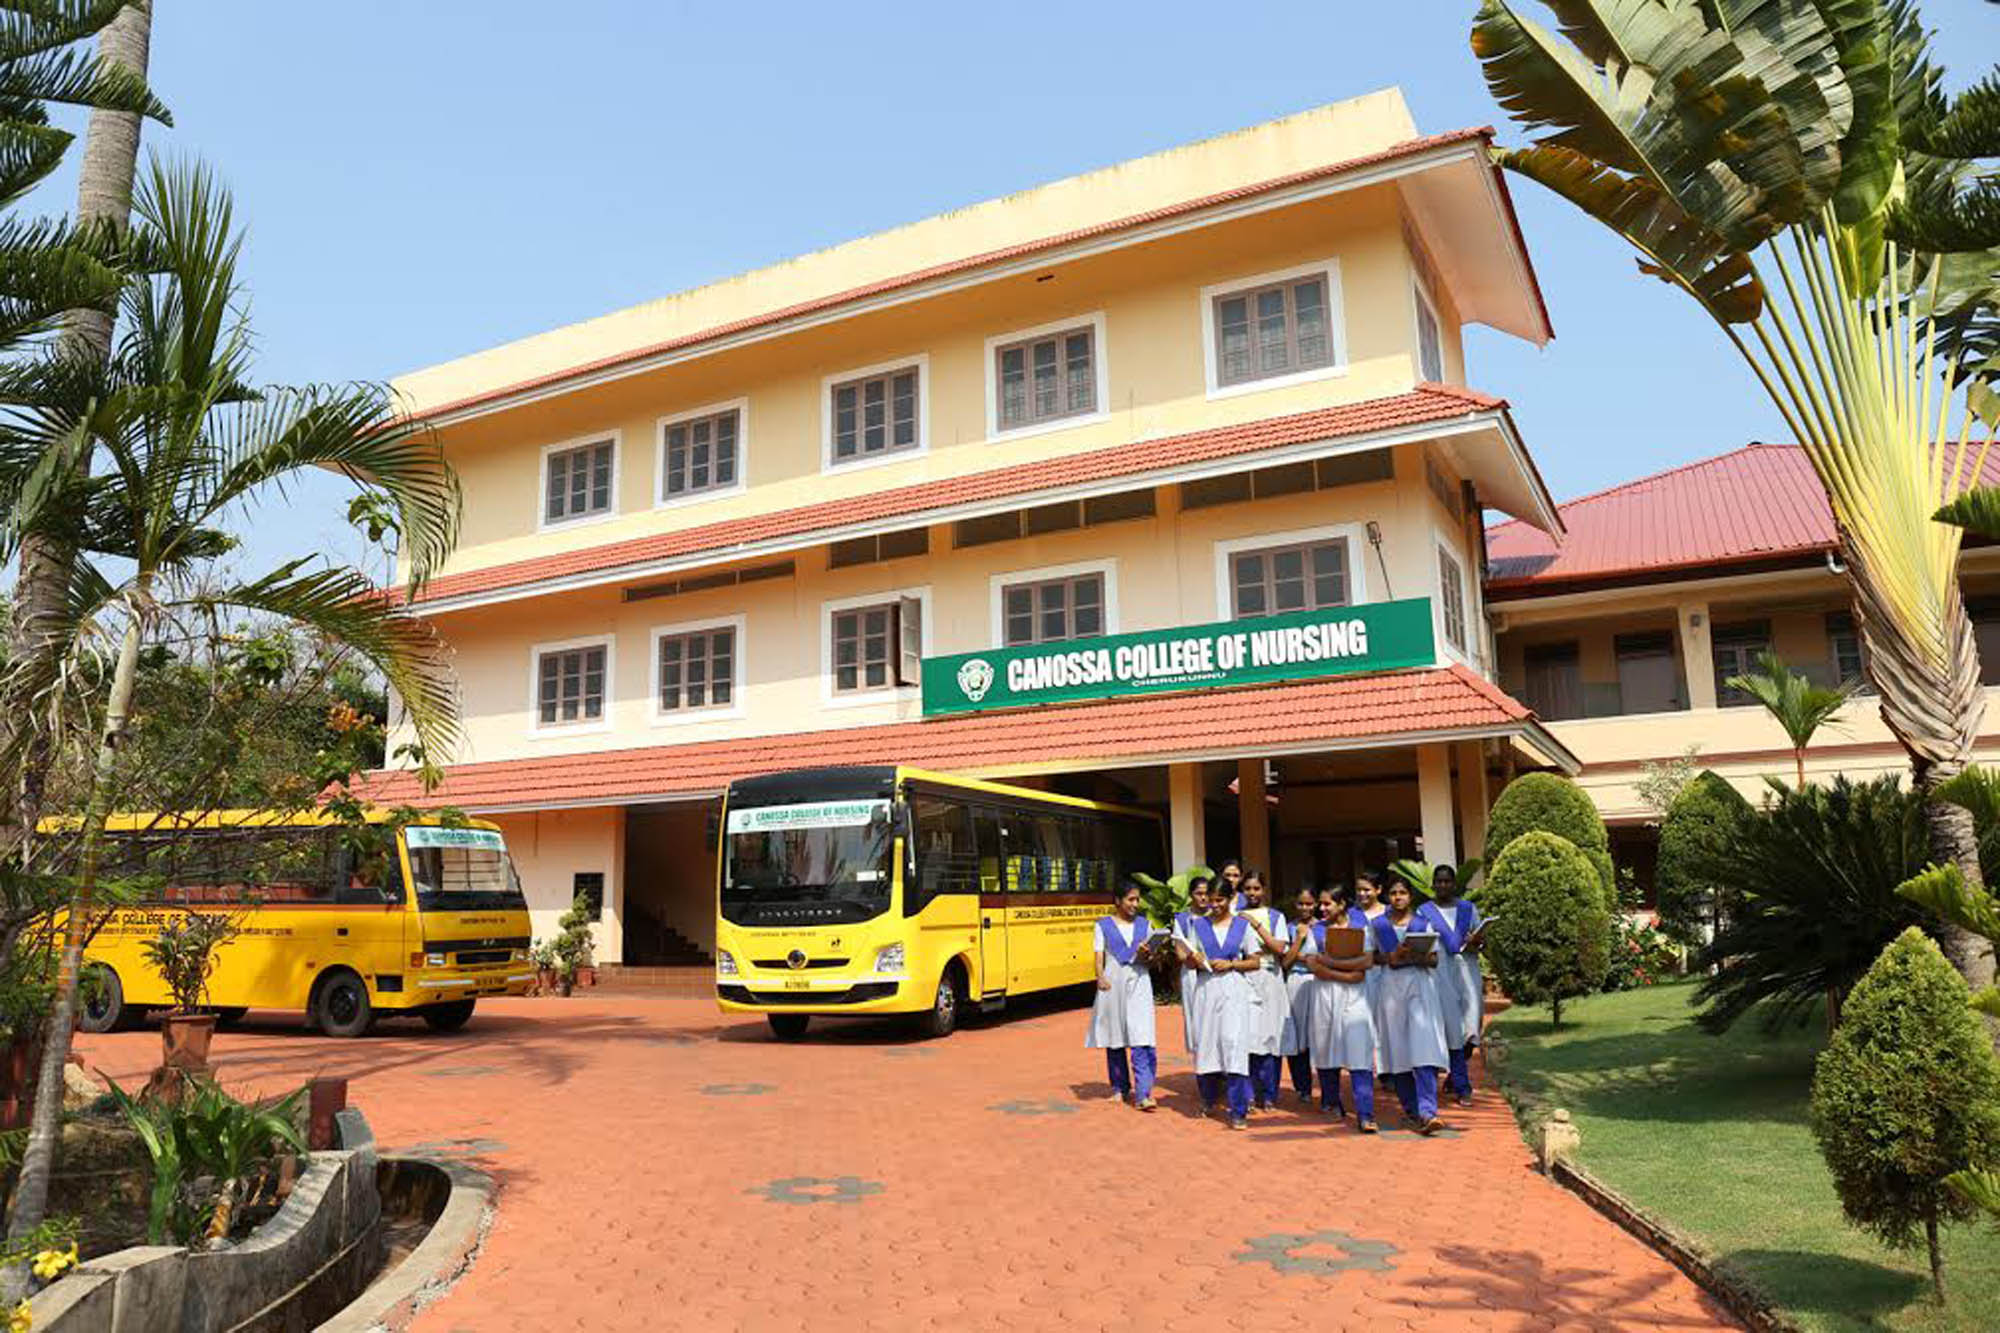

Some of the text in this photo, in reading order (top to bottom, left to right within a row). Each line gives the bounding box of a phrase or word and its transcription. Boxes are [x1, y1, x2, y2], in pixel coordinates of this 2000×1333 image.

[1007, 619, 1368, 691] CANOSSA COLLEGE OF NURSING
[1131, 672, 1227, 687] CHERUKUNNU
